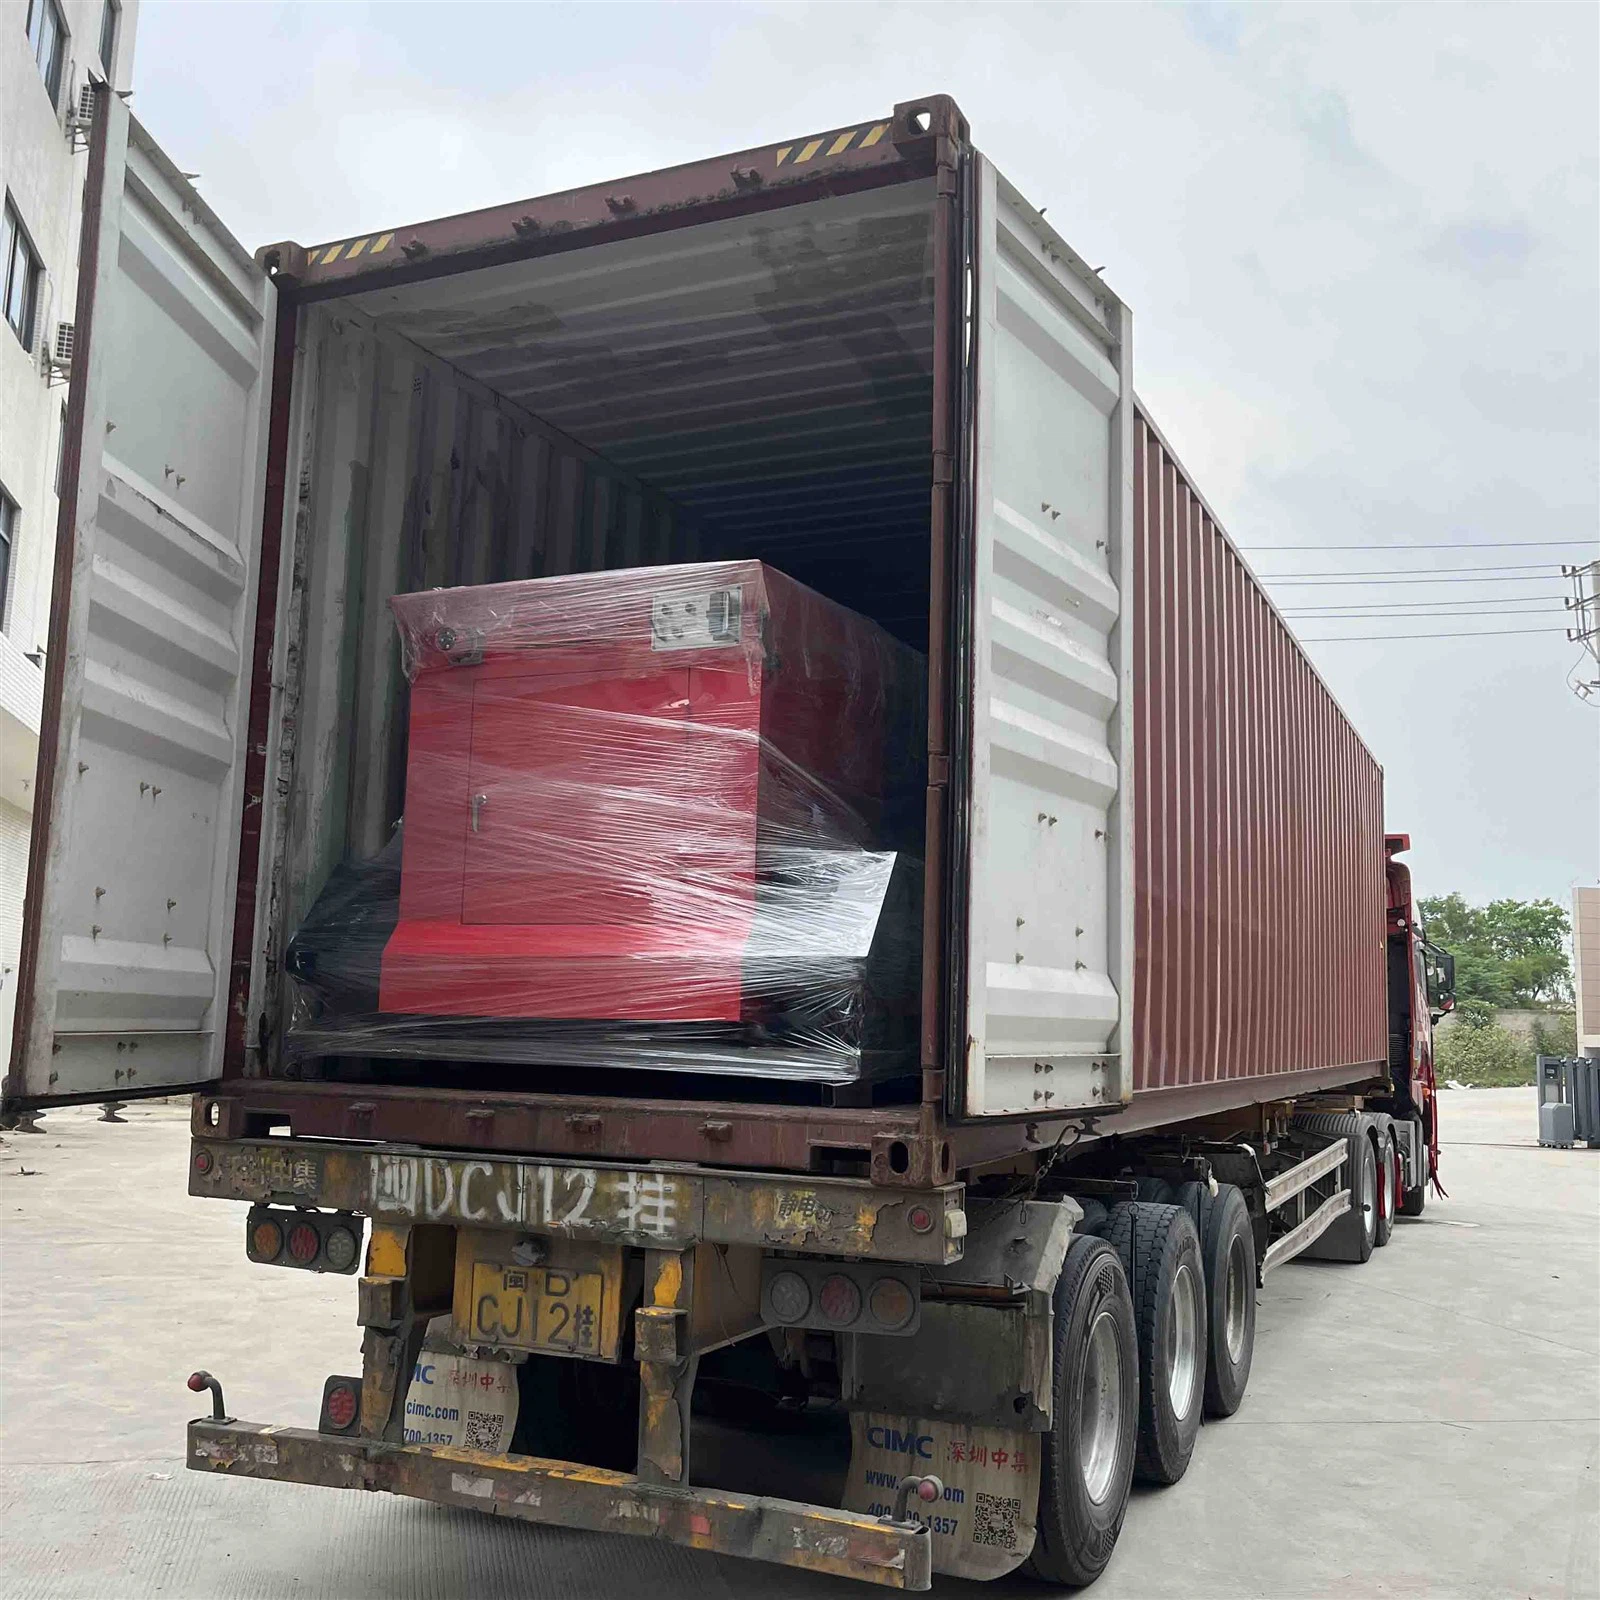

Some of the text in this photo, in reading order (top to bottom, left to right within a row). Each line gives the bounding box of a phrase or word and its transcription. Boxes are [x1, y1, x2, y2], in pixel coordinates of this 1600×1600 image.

[866, 1426, 934, 1460] CIMC
[946, 1439, 1029, 1474] 深圳中集
